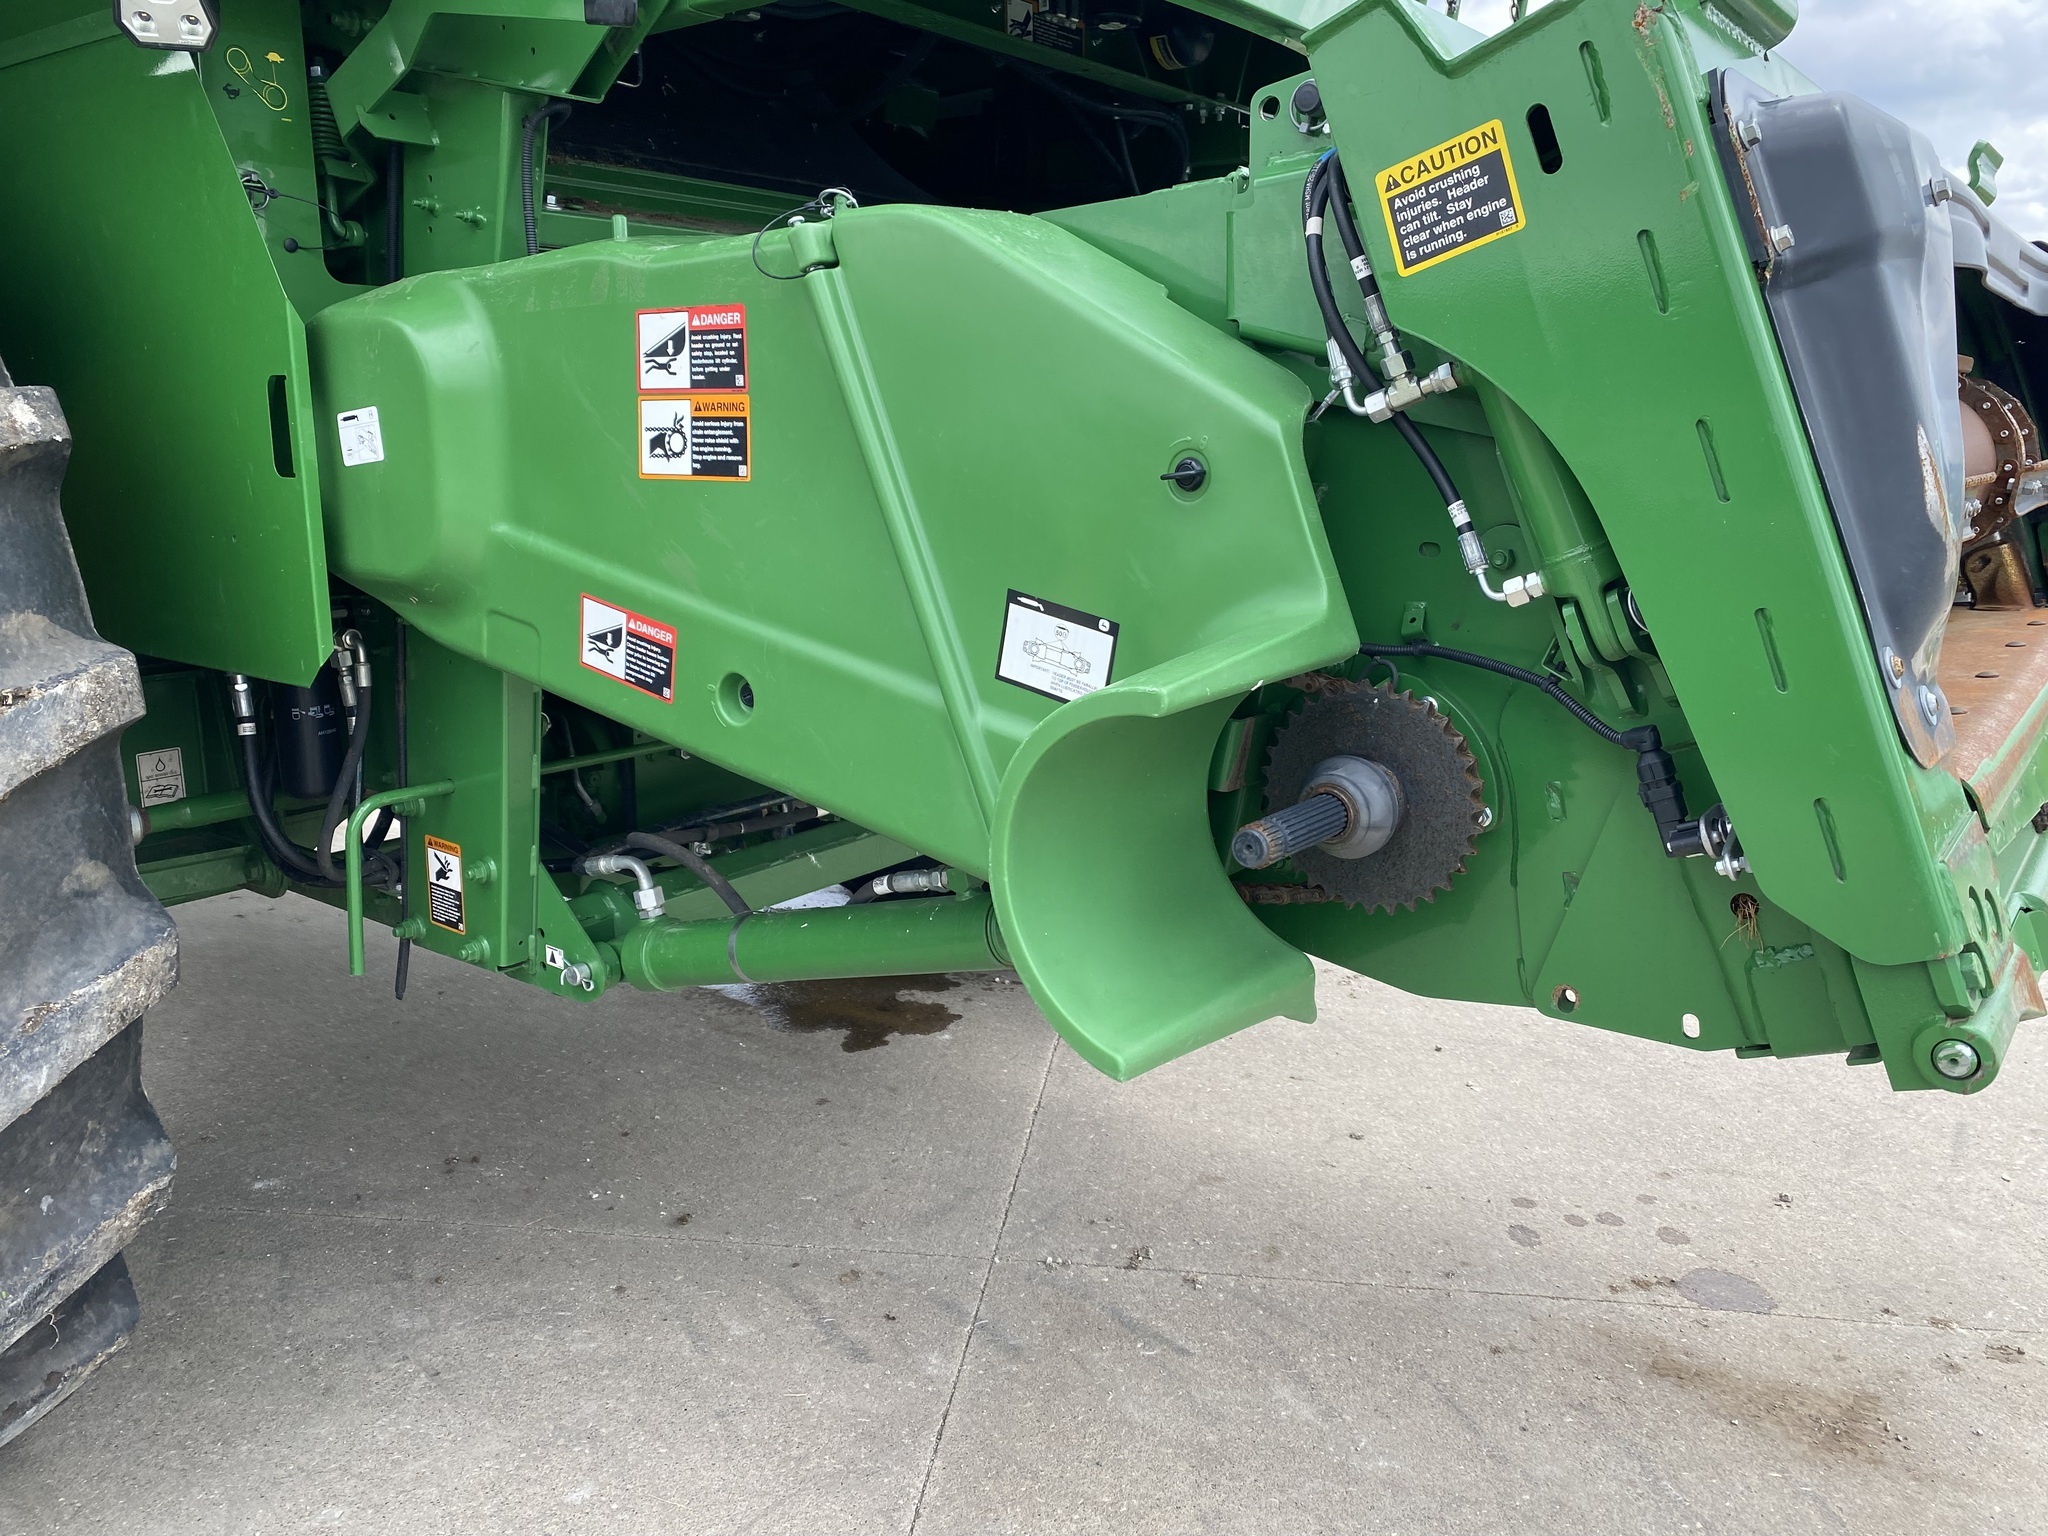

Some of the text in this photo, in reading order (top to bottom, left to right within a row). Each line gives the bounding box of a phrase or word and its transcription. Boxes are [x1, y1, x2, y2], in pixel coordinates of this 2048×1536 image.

[1400, 127, 1498, 184] CAUTION
[1394, 165, 1480, 209] Avoid crushing
[1396, 174, 1489, 223] injuries. Header
[1400, 196, 1473, 234] can tilt. Stay
[1403, 197, 1507, 248] clear when engine
[1406, 230, 1467, 260] is running.
[701, 312, 741, 326] DANGER
[703, 402, 745, 412] WARNING
[636, 621, 672, 644] DANGER
[433, 840, 458, 854] WARNING
